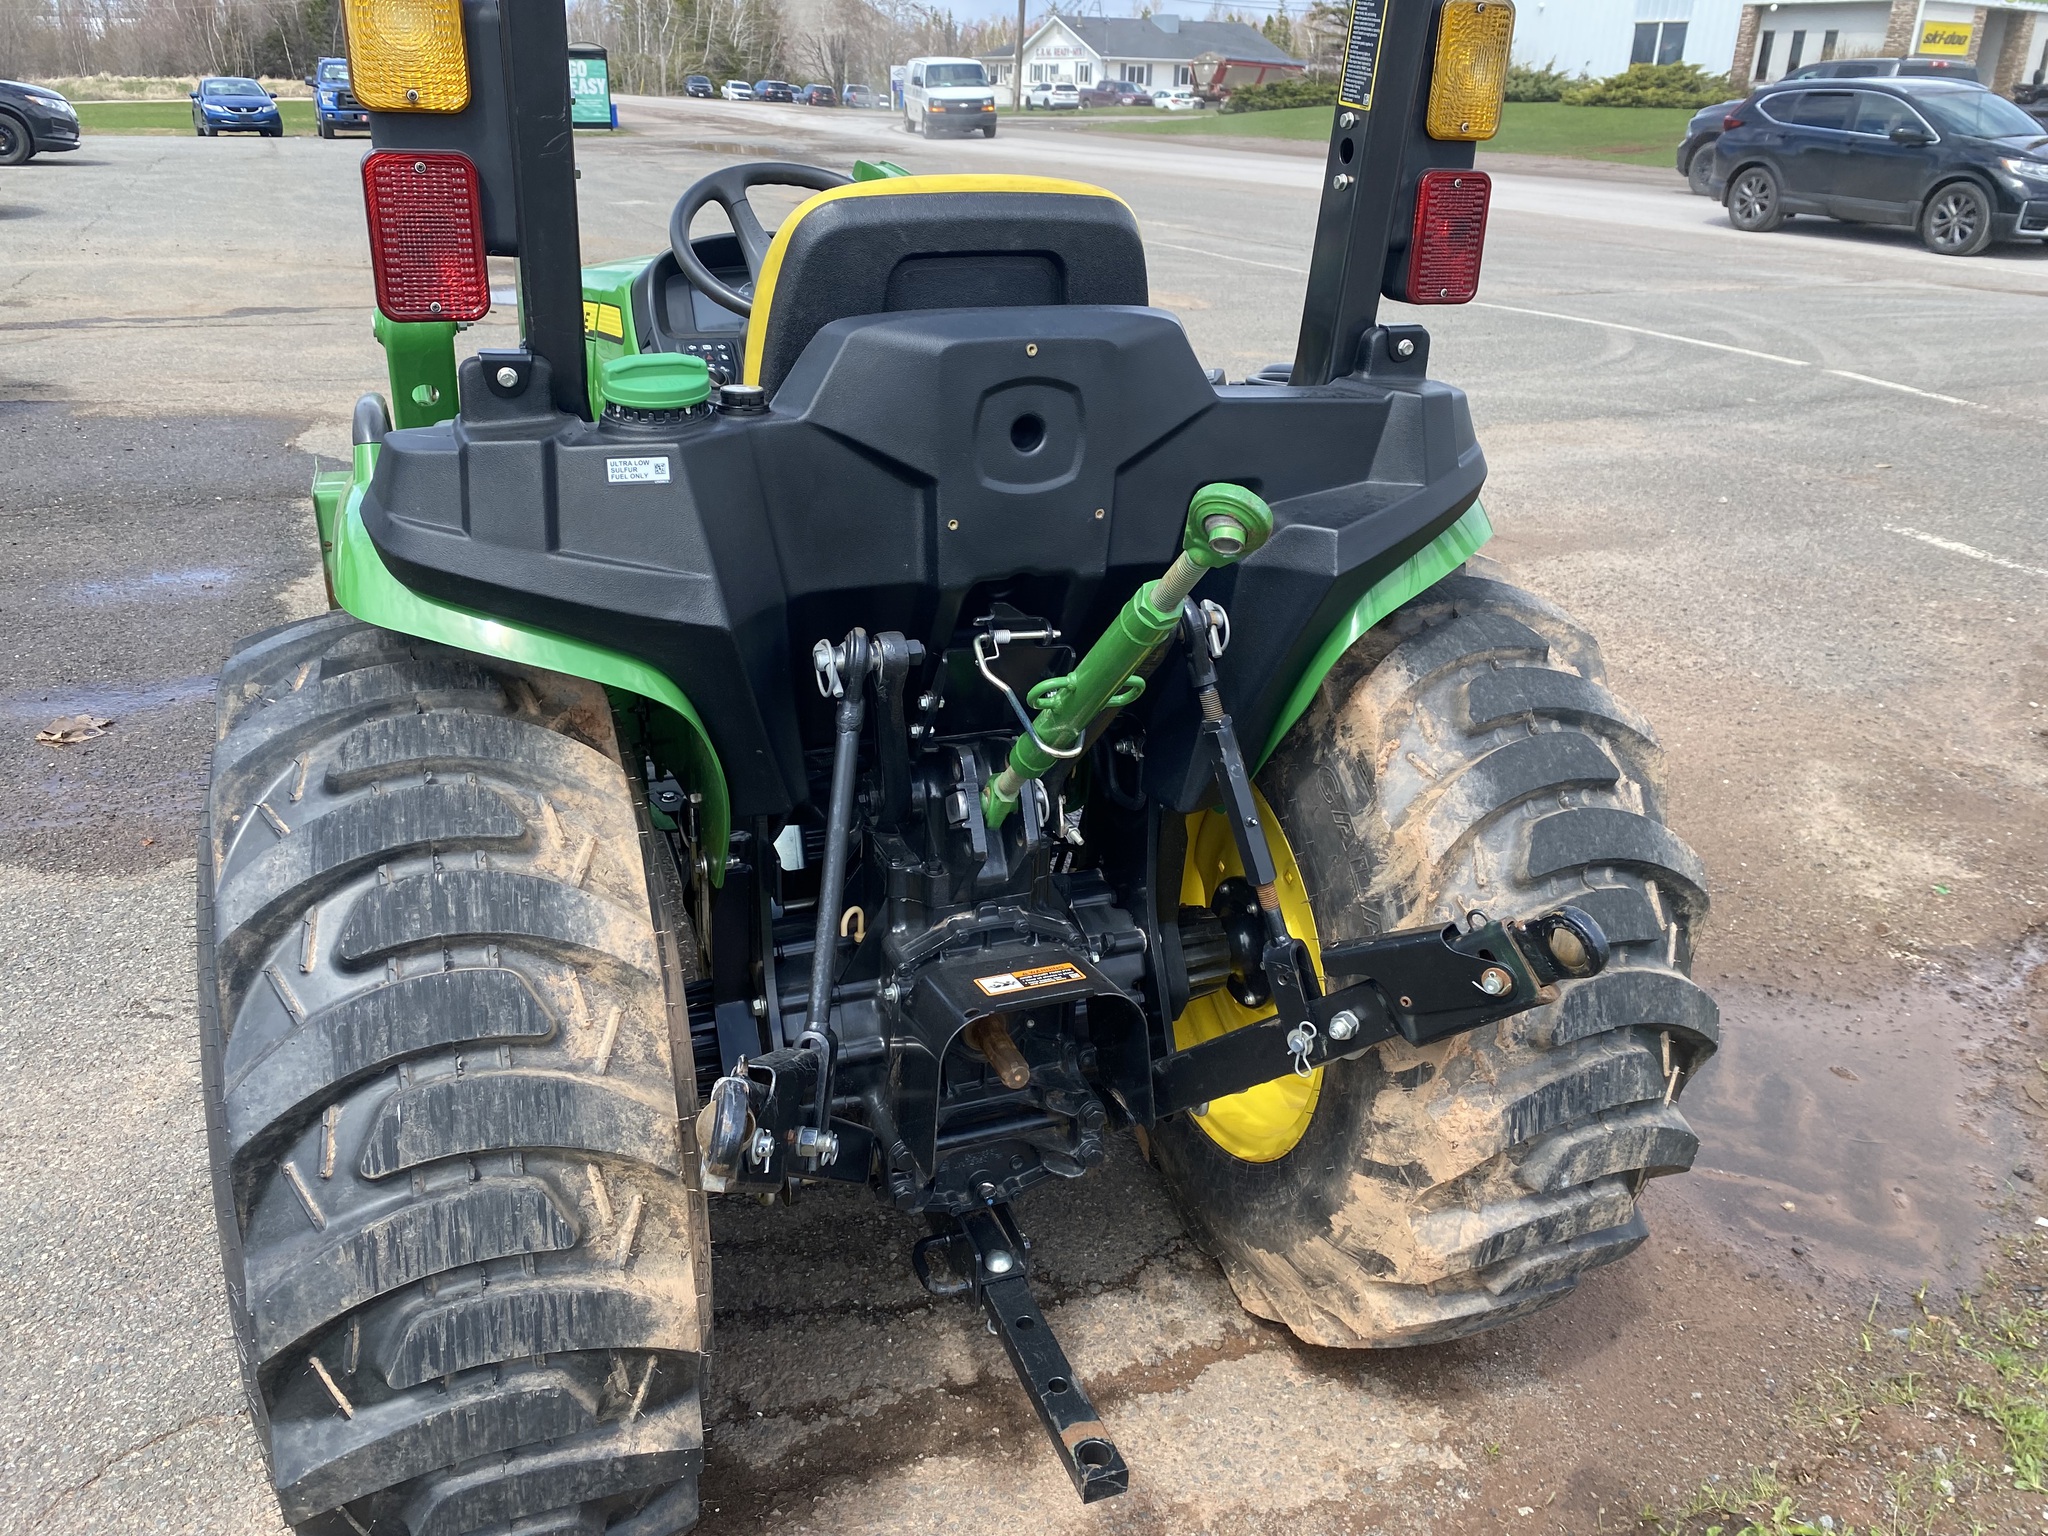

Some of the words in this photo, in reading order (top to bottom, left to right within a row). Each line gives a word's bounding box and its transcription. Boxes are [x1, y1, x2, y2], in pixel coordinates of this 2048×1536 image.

[1923, 30, 1968, 45] ski-doo
[569, 60, 587, 77] GO
[570, 78, 606, 94] EASY
